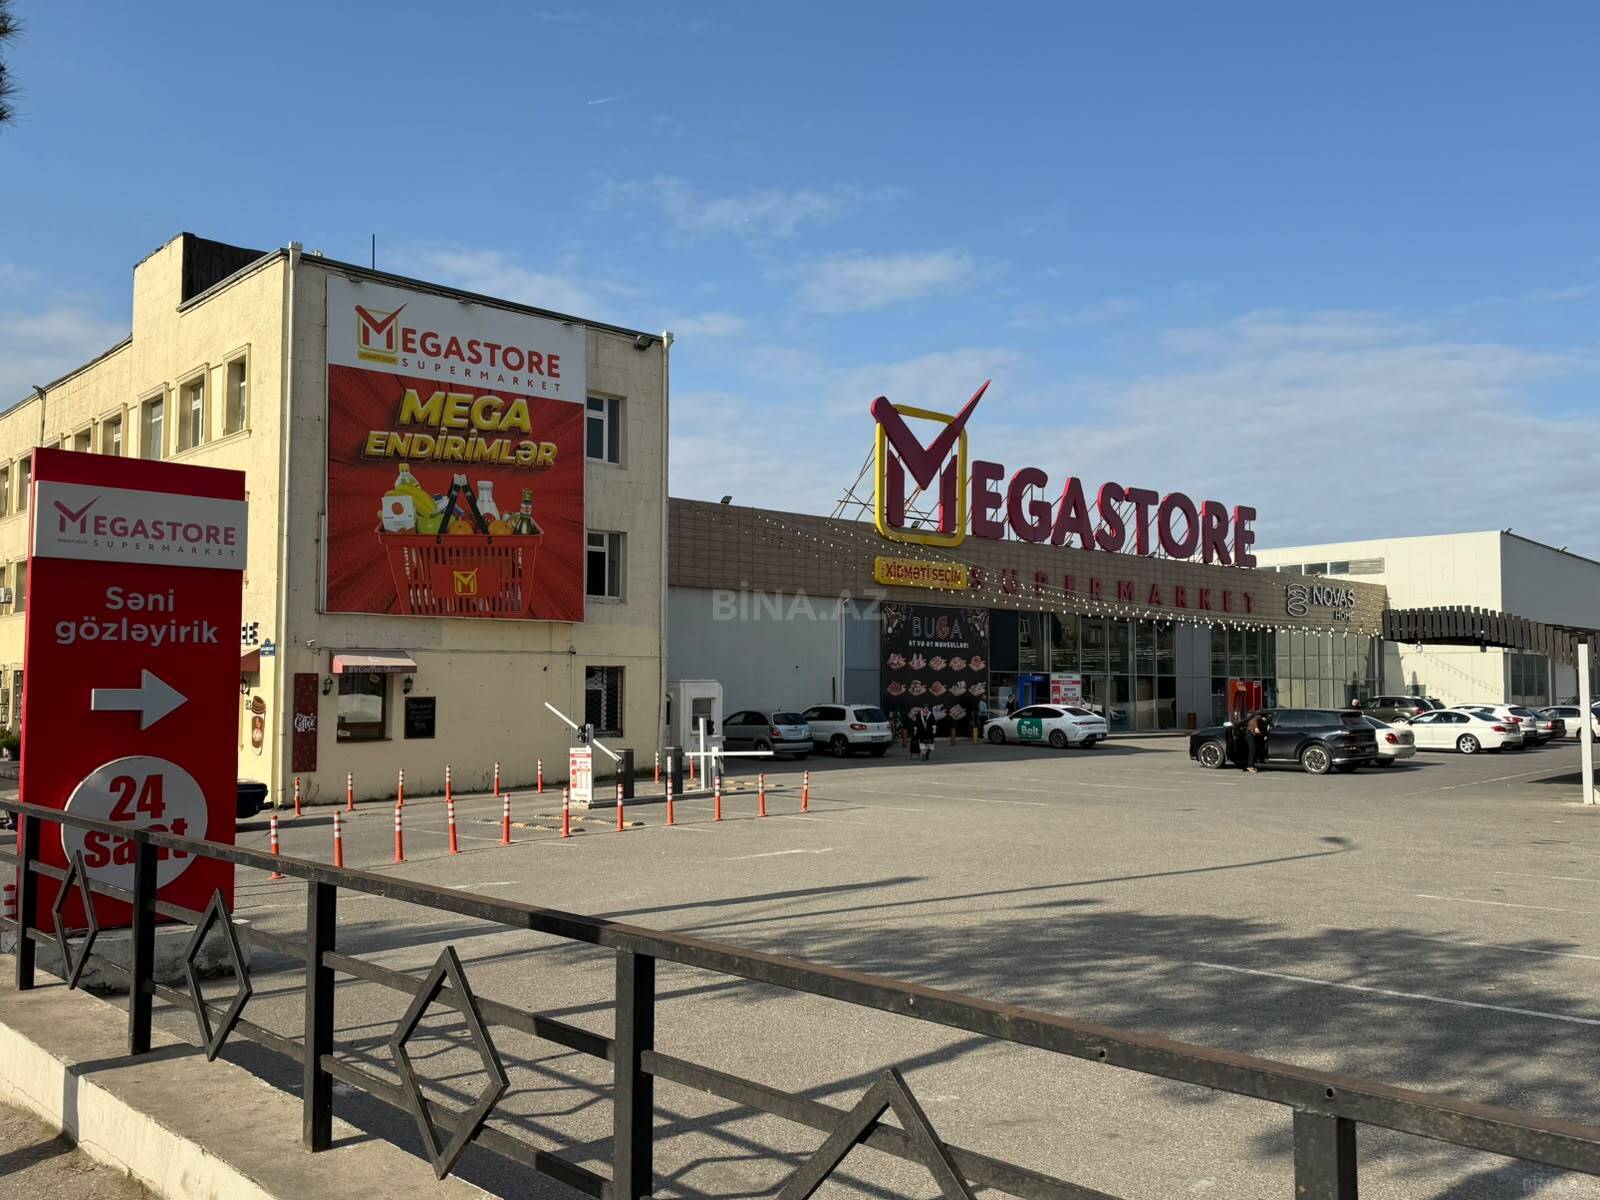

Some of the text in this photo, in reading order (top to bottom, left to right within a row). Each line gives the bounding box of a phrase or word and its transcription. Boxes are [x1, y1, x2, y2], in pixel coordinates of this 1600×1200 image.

[355, 302, 561, 379] MEGASTORE
[402, 357, 562, 393] SUPERMARKET
[398, 387, 533, 435] MEGA
[364, 427, 558, 465] ENDİRİMLƏR
[867, 380, 1257, 569] MEGASTORE
[53, 495, 237, 546] MEGASTORE
[93, 539, 237, 558] SUPERMARKET
[105, 586, 175, 613] Səni
[969, 566, 1256, 614] SUPERMARKET
[1312, 585, 1355, 608] NOVAS
[55, 616, 218, 646] gözləyirik
[1020, 725, 1041, 738] Bolt
[109, 774, 166, 822] 24
